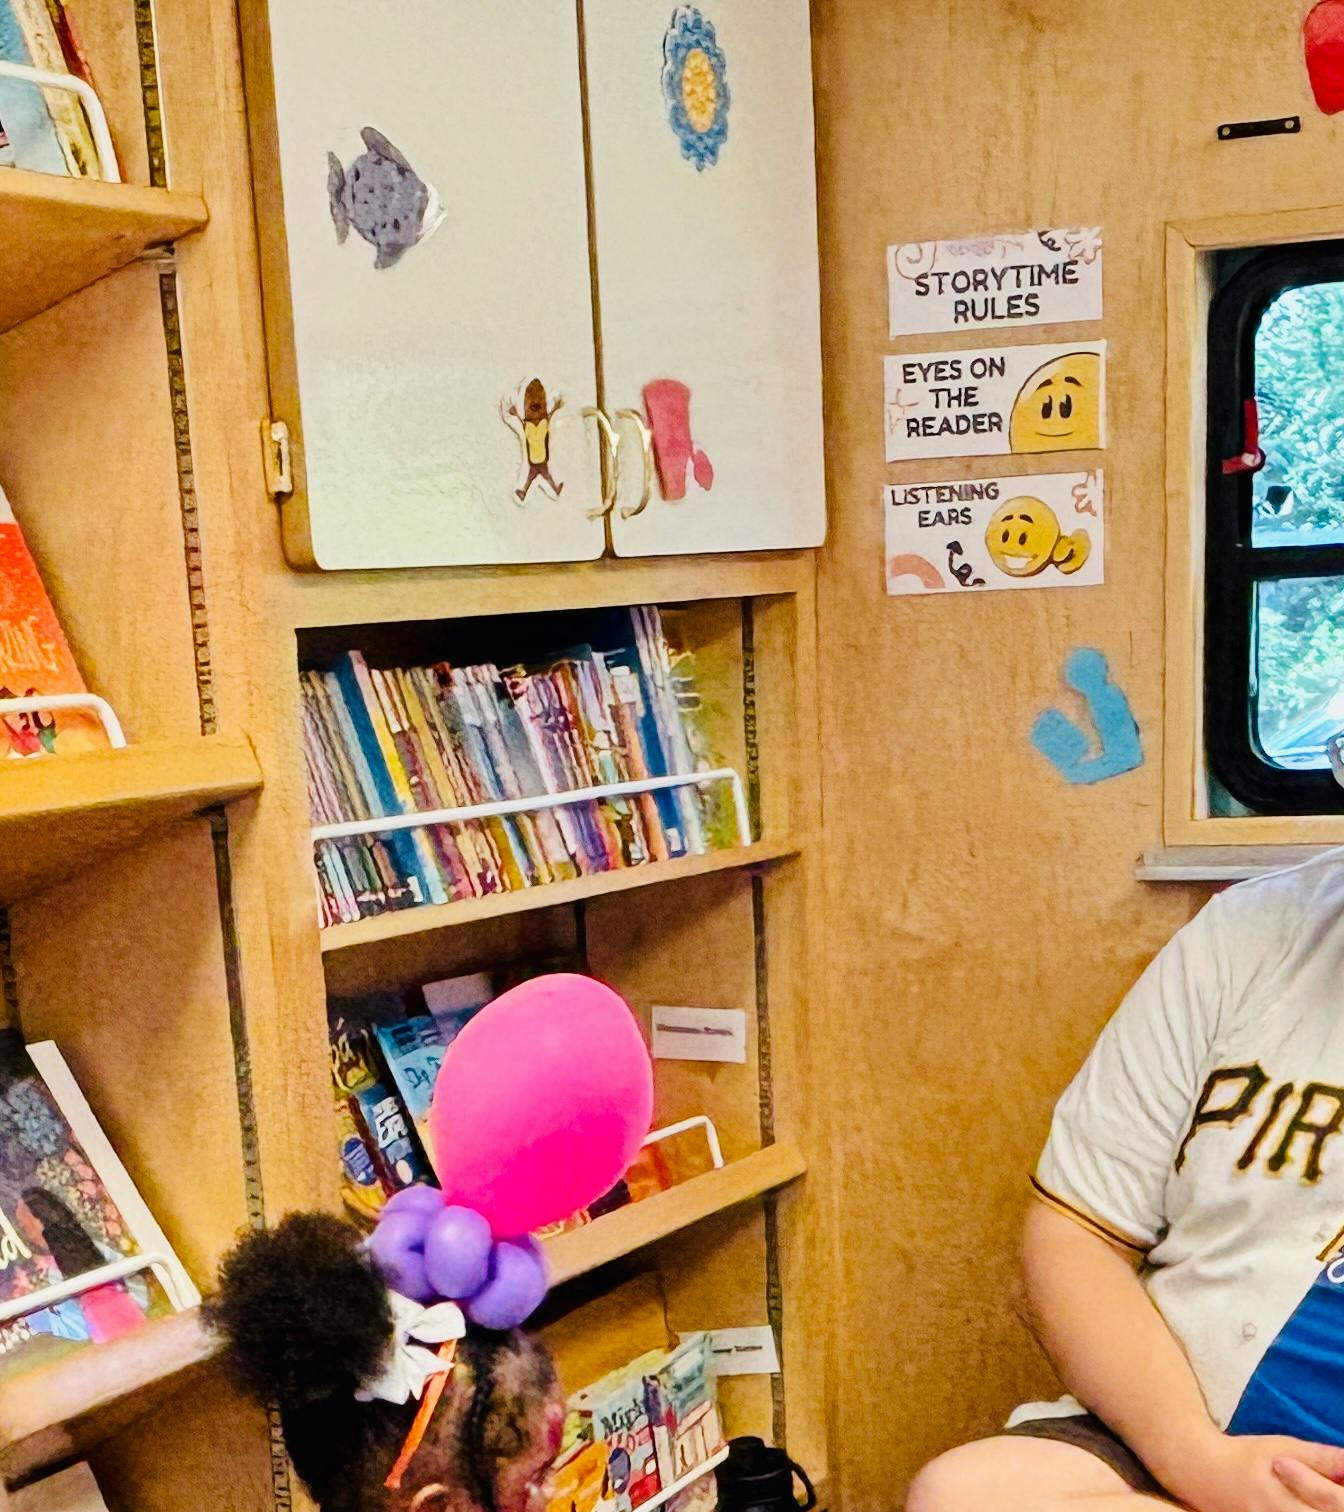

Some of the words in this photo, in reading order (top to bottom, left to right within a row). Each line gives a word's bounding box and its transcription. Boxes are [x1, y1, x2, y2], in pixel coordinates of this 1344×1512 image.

[914, 259, 1080, 297] STORYTIME
[954, 293, 1041, 324] RULES
[902, 359, 963, 384] EYES
[970, 356, 1006, 380] ON
[928, 386, 979, 409] THE
[906, 412, 1003, 438] READER
[890, 481, 1000, 507] LISTENING
[917, 508, 973, 528] EARS
